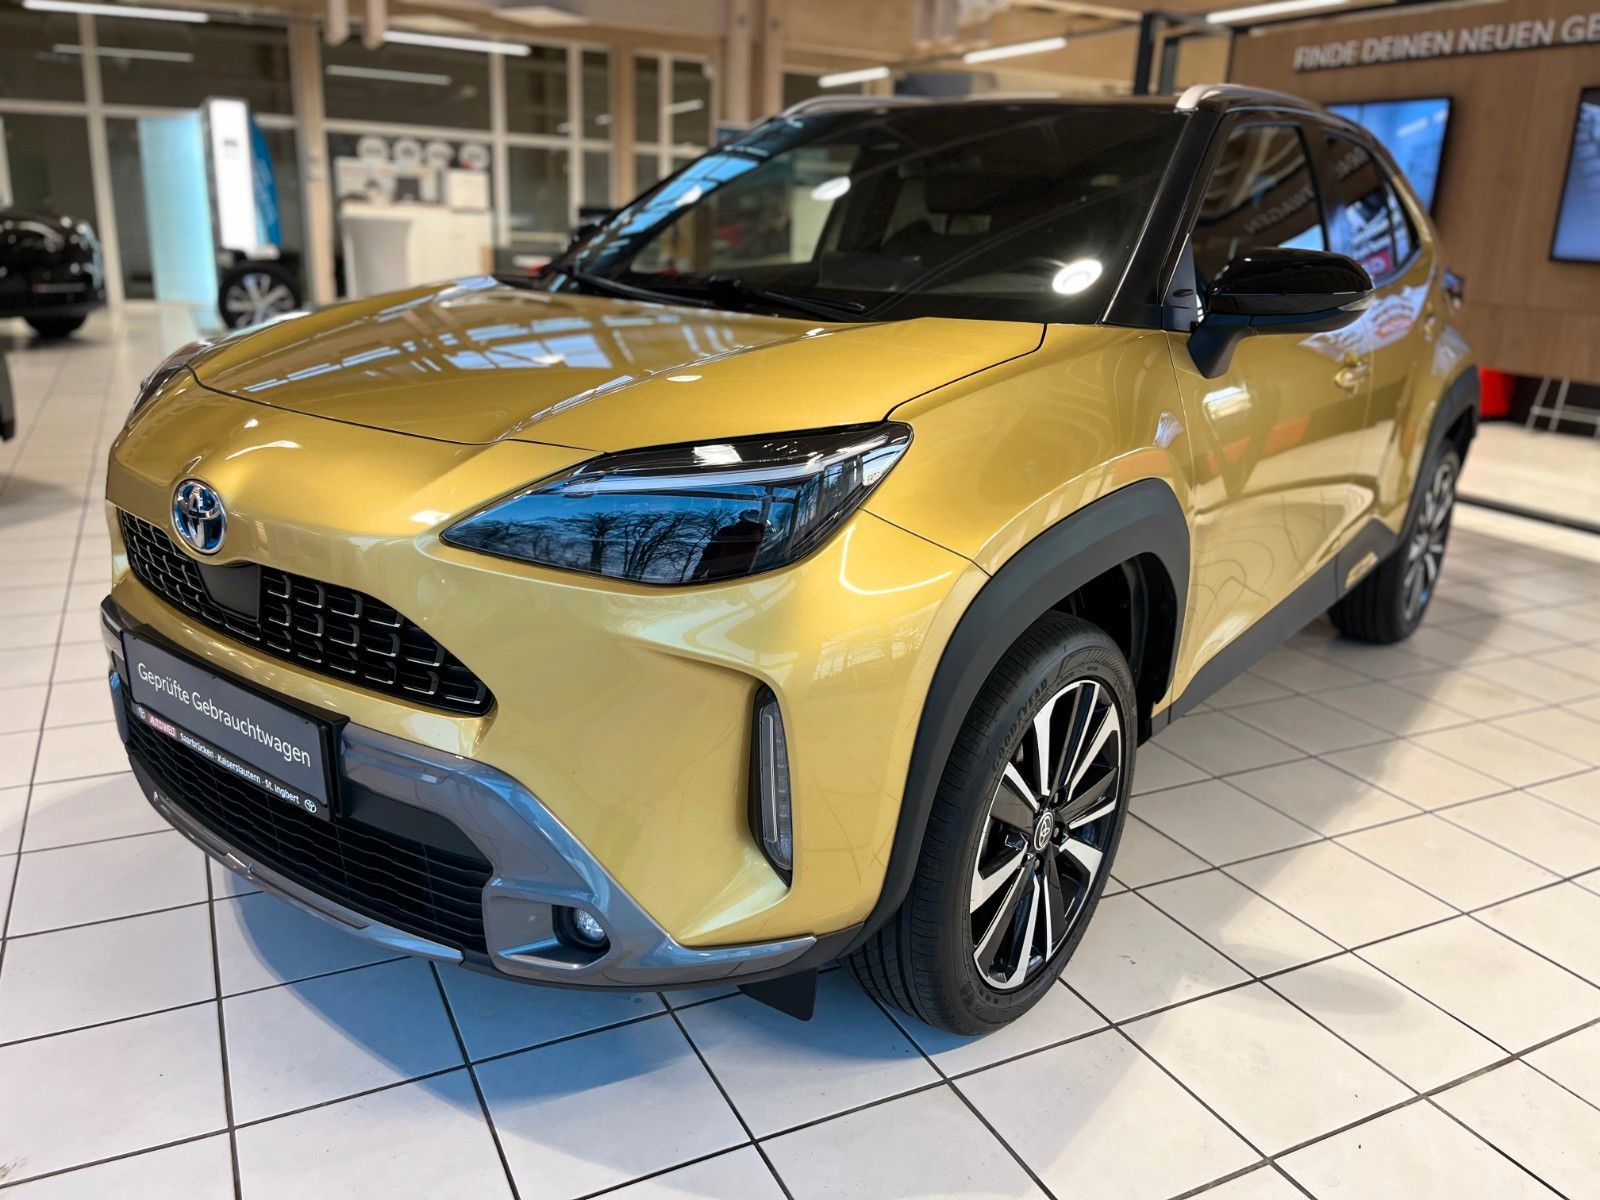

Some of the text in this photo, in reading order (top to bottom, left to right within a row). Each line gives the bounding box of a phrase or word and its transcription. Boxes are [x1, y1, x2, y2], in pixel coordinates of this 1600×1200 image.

[1293, 37, 1361, 71] FINDE
[1362, 30, 1454, 63] DEINEN
[1457, 17, 1556, 53] NEUEN
[138, 662, 190, 705] Geprüfte
[192, 692, 311, 768] Gebrauchtwagen
[217, 753, 261, 784] Kaiserslautern
[274, 784, 300, 805] Ingbert
